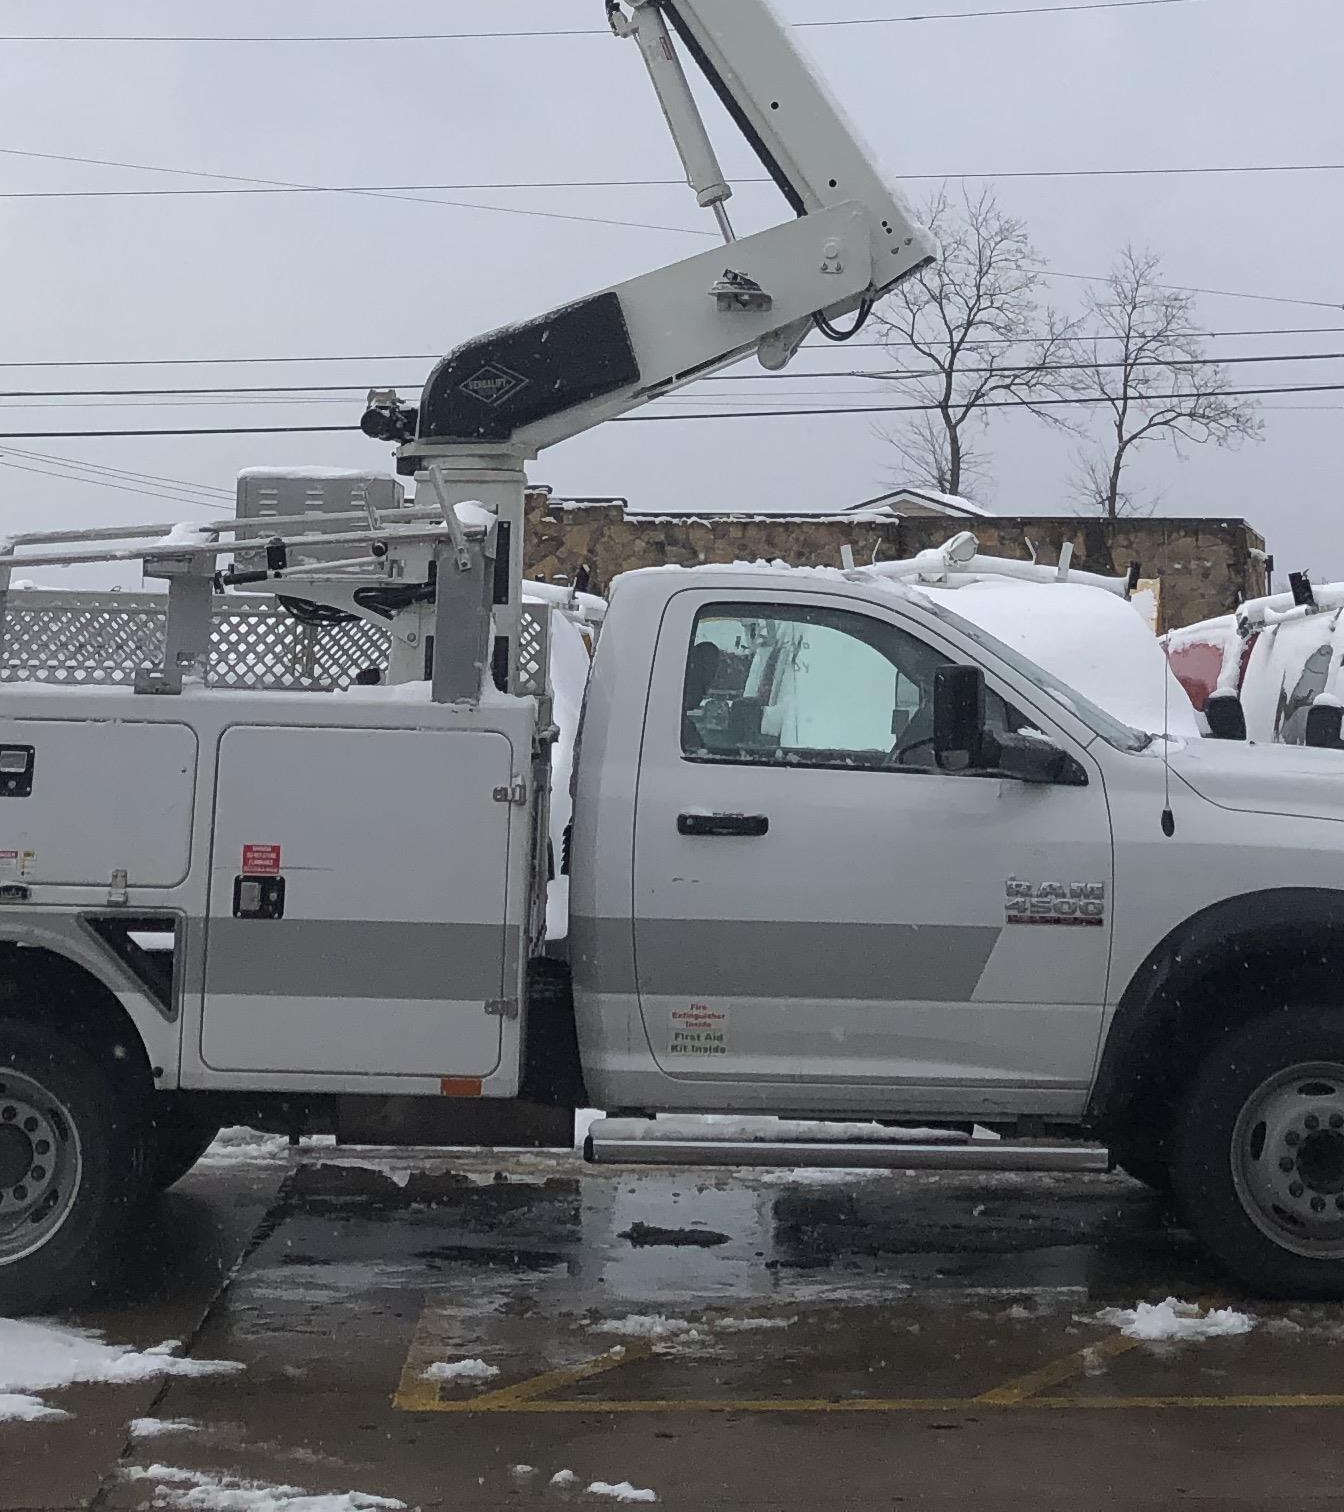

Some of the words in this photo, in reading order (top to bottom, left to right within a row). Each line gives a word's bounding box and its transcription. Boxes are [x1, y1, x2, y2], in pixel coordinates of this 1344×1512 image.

[1006, 880, 1104, 899] RAM
[1005, 898, 1104, 915] 4500
[674, 1032, 701, 1041] First
[705, 1032, 723, 1041] Aid
[671, 1044, 688, 1053] Kit
[691, 1044, 726, 1054] Inside
